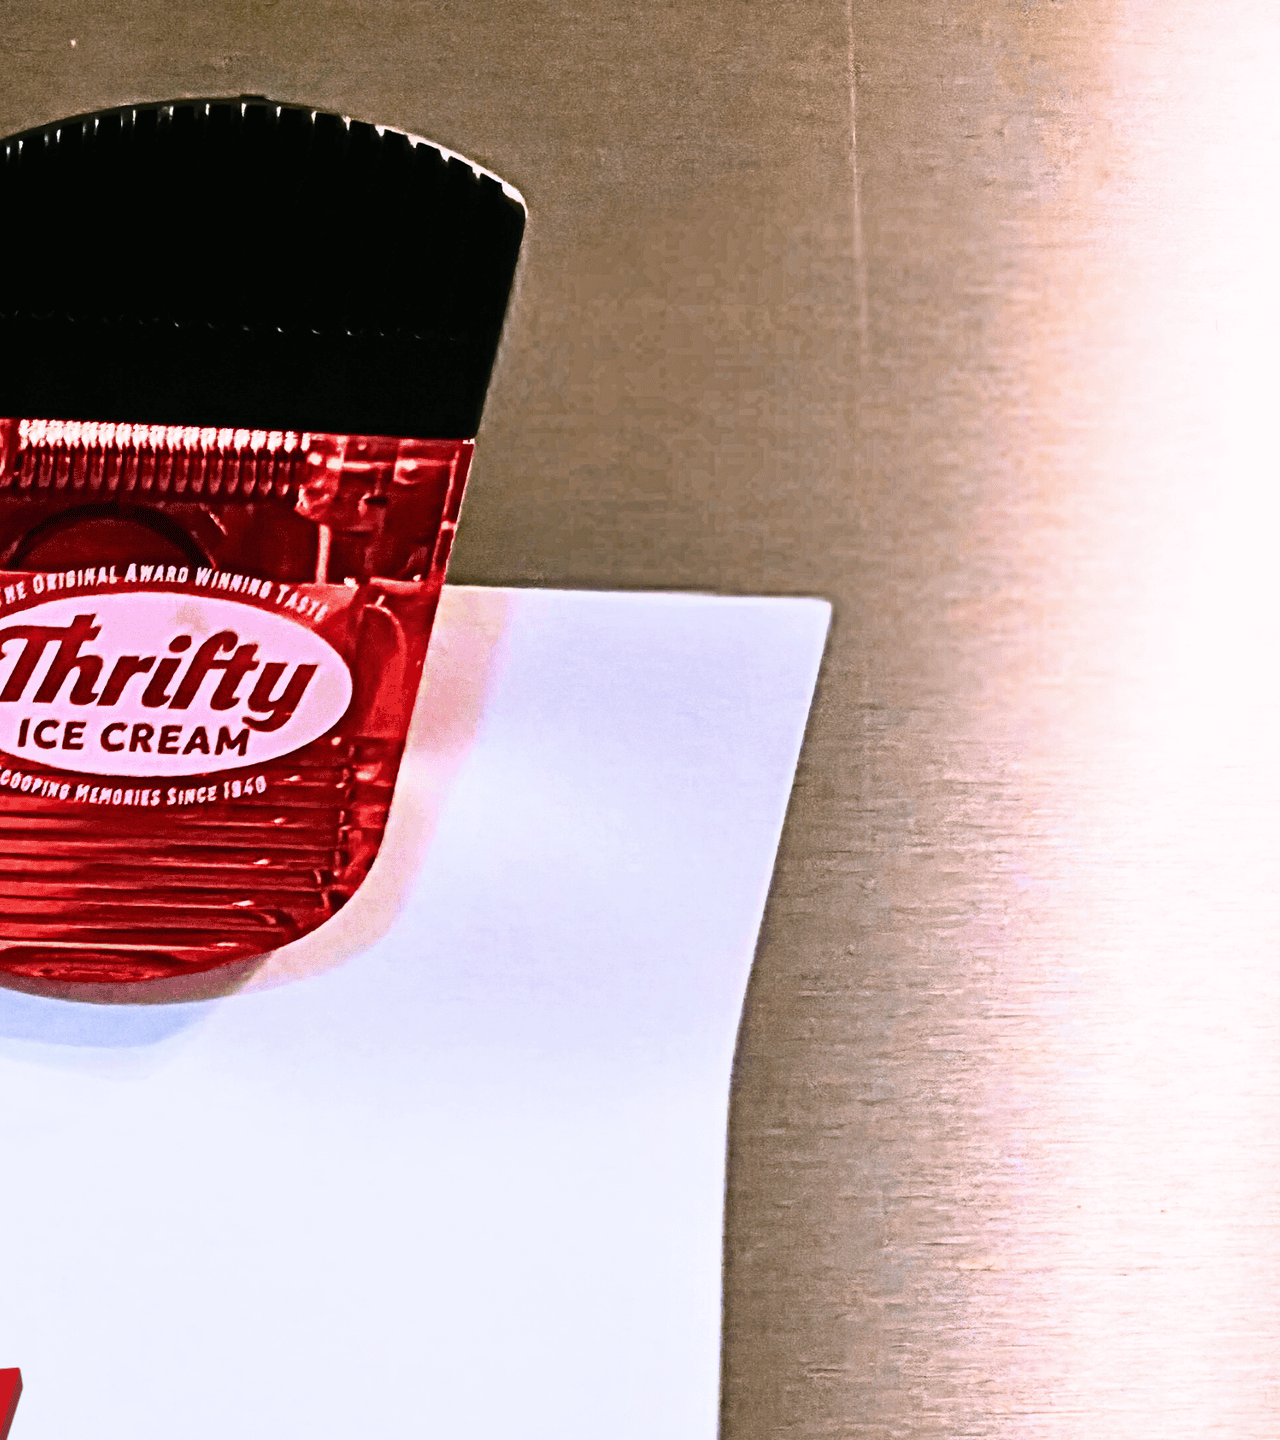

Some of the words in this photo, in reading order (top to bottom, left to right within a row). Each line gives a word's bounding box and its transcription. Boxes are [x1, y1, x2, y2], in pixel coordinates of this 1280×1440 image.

[16, 718, 85, 751] ICE
[98, 720, 250, 757] CREAM
[223, 775, 268, 799] 1940
